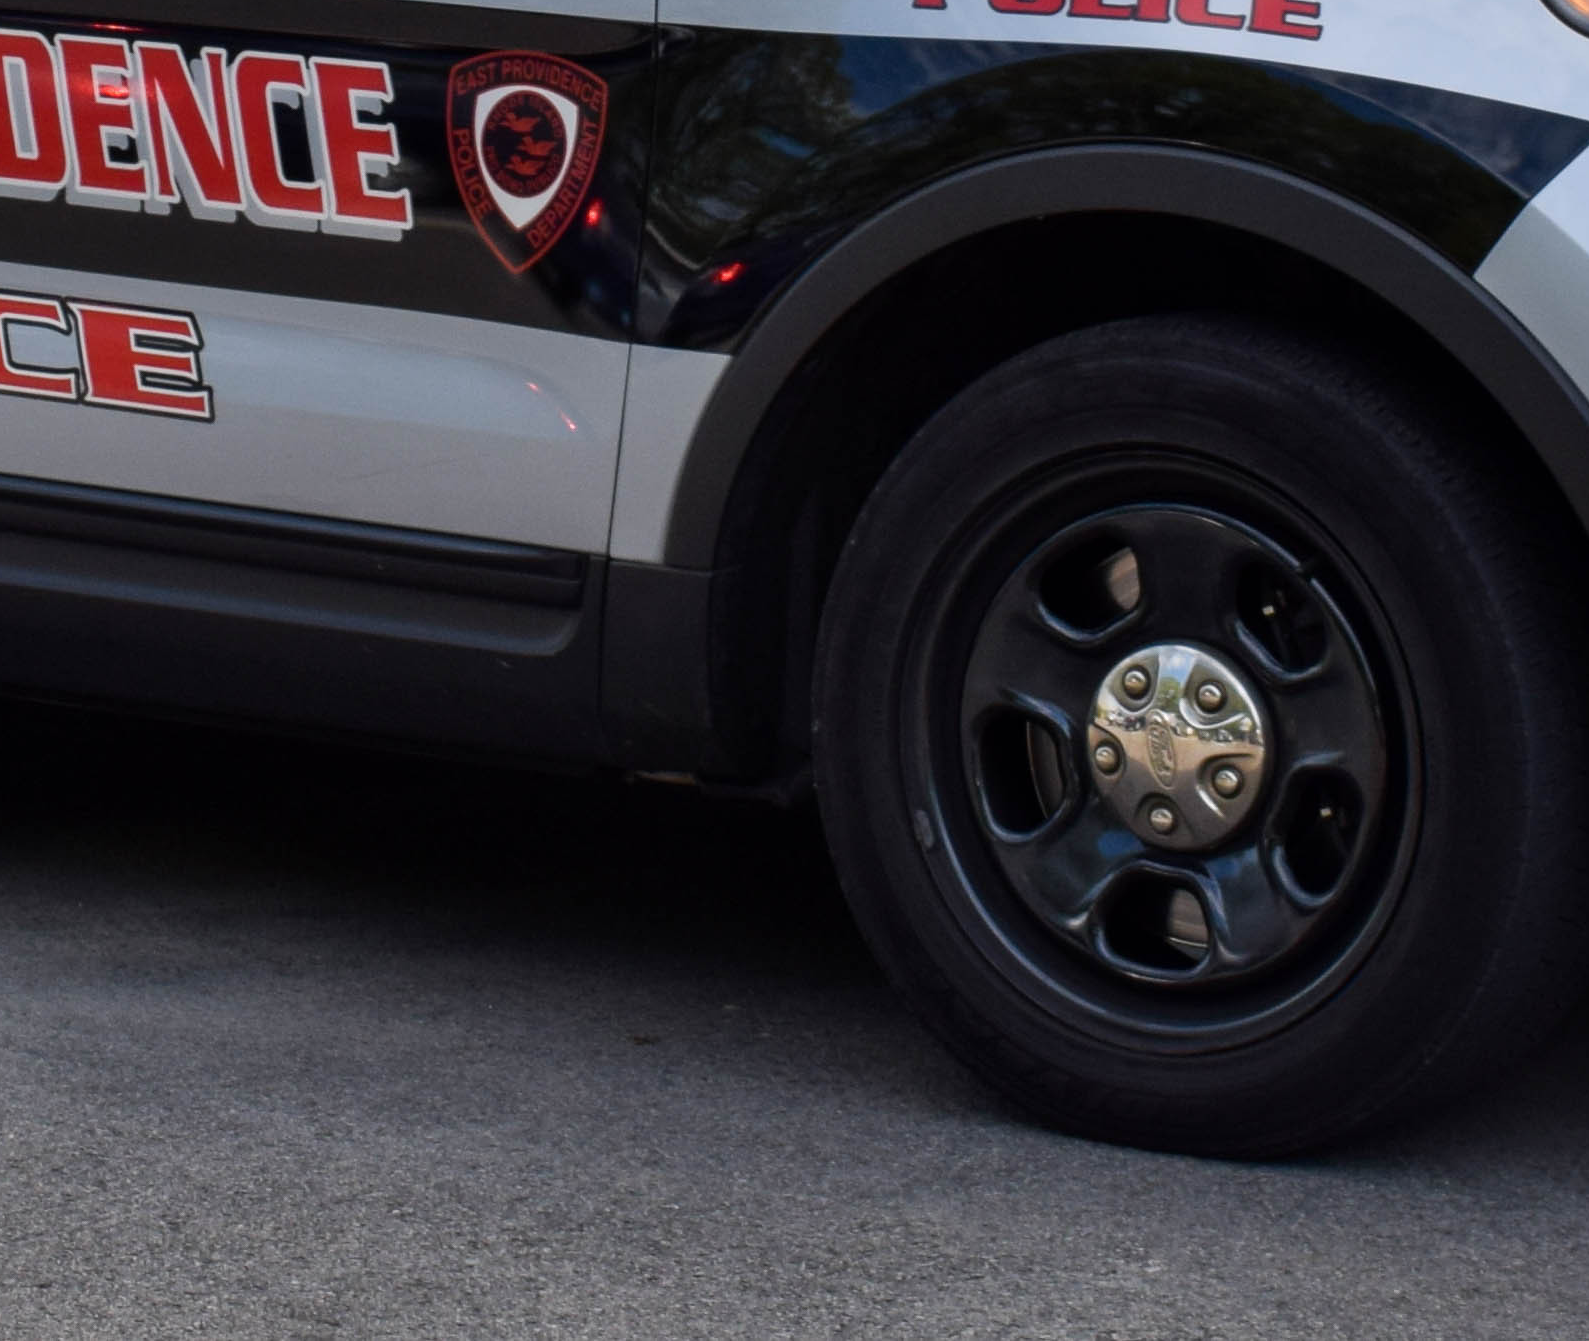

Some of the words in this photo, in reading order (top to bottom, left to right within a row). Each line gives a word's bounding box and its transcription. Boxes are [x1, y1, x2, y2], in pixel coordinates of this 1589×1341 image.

[456, 63, 496, 95] EAST
[502, 60, 603, 110] PROVIDENCE
[452, 129, 494, 218] POLICE
[526, 117, 598, 248] DEPARTMENT
